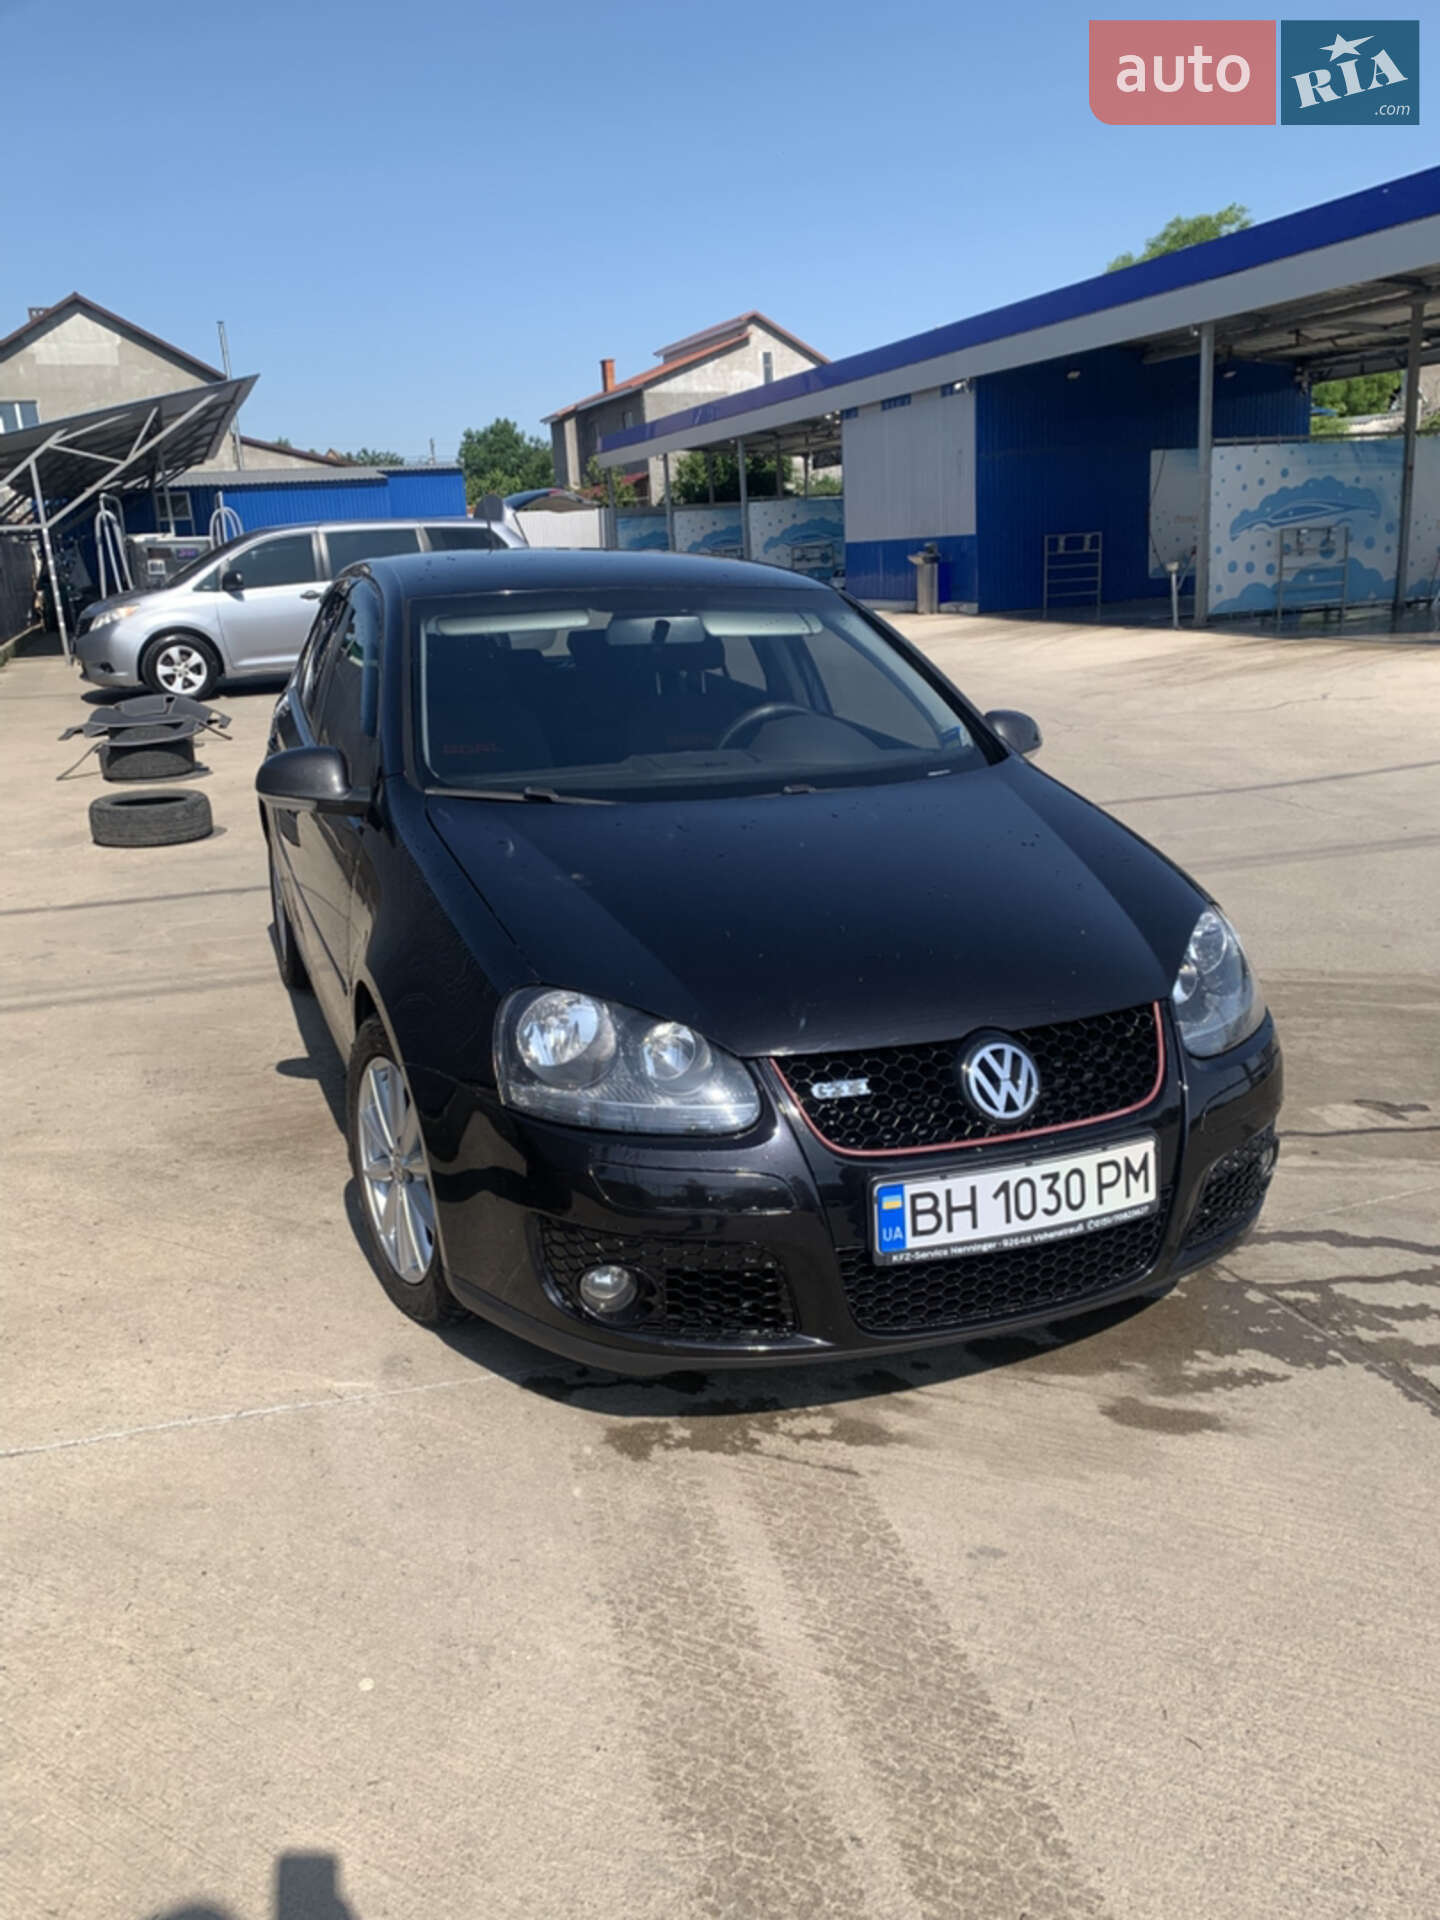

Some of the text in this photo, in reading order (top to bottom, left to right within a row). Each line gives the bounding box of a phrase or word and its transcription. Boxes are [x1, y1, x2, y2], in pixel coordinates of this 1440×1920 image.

[910, 1185, 978, 1237] BH
[992, 1168, 1086, 1224] 1030
[1097, 1152, 1149, 1205] PM
[882, 1226, 904, 1242] UA
